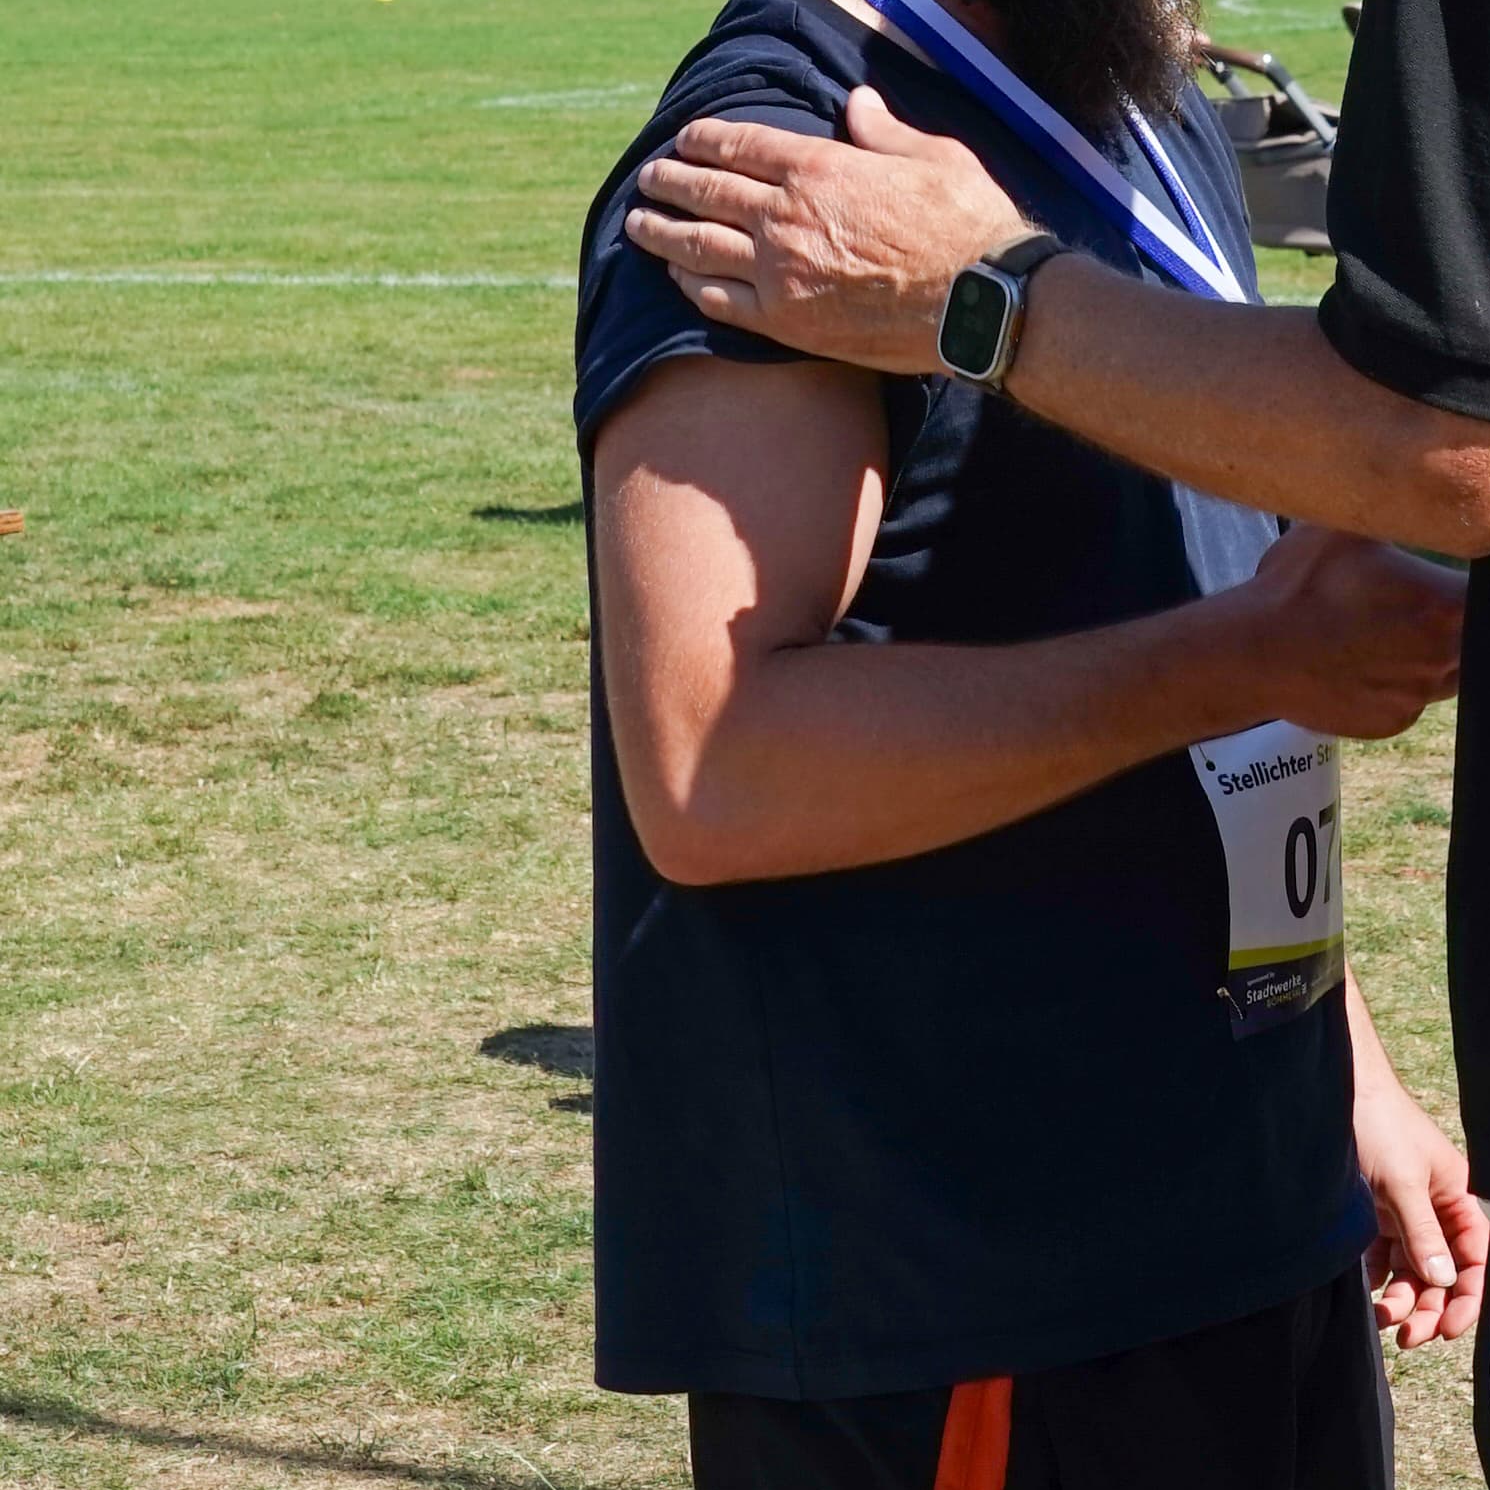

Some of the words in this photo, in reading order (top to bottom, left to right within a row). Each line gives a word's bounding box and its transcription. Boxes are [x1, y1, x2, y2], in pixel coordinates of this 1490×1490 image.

[1218, 754, 1313, 795] Stellichter
[1285, 801, 1342, 919] 07
[1246, 974, 1302, 1005] Stadtwerke
